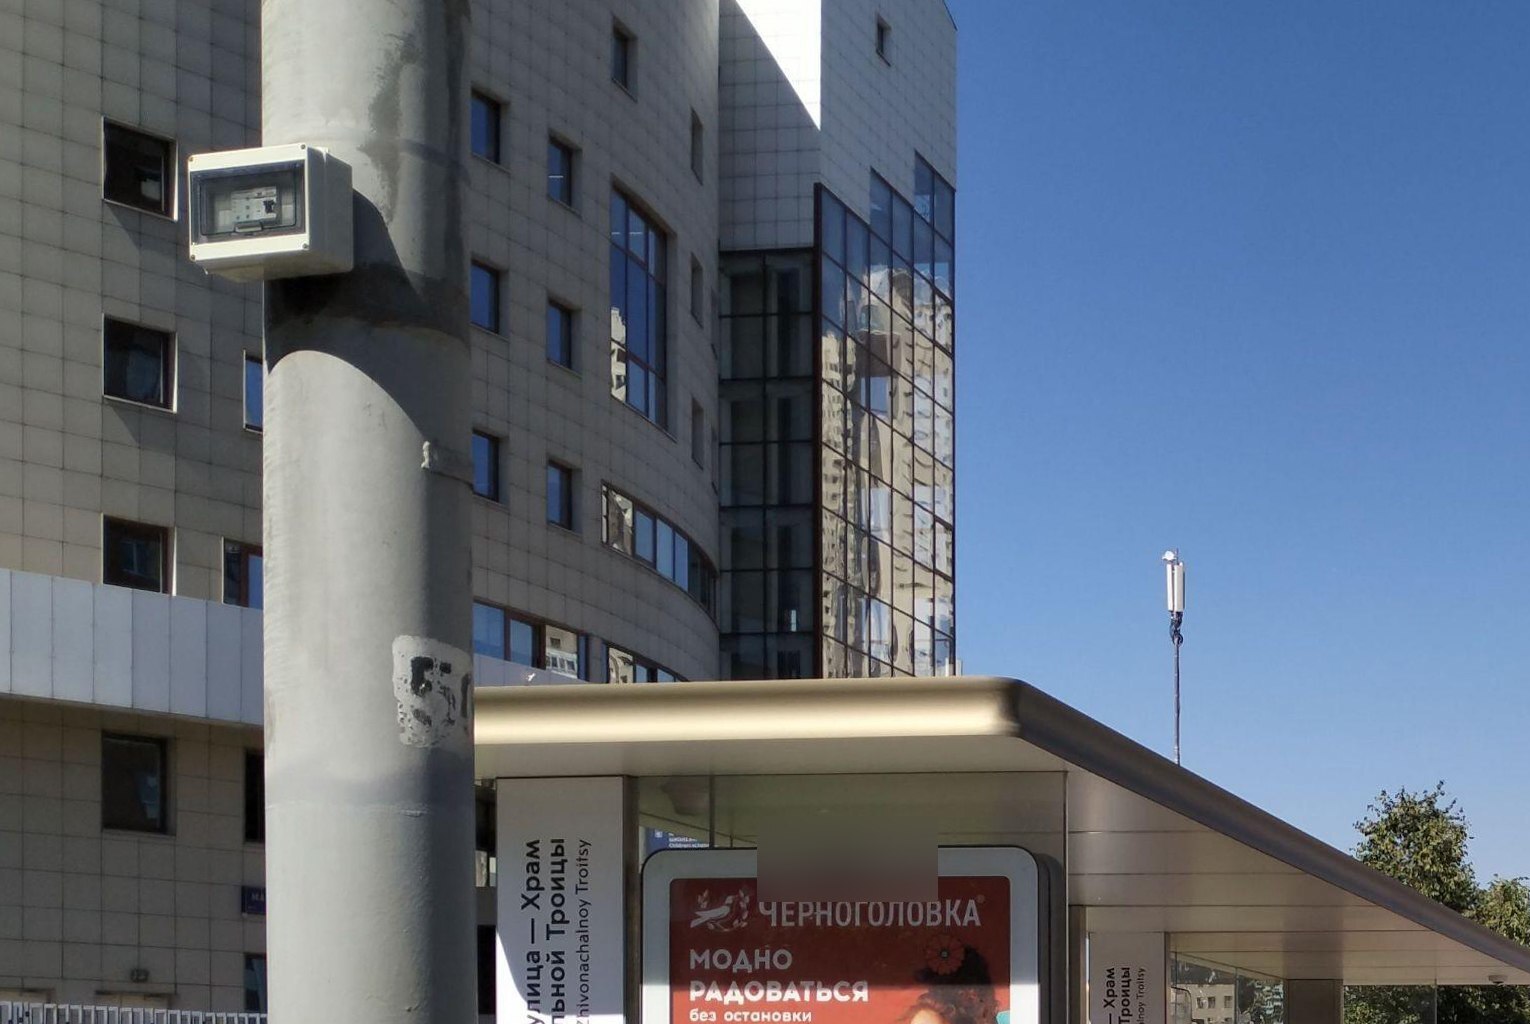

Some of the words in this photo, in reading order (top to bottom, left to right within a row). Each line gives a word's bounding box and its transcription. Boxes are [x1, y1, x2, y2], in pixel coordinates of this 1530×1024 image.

[521, 839, 545, 910] Храм
[575, 839, 592, 895] Troitsy
[546, 838, 570, 941] Троицы
[758, 899, 982, 928] ЧЕРНОГОЛОВКА
[689, 948, 793, 973] МОДНО
[689, 980, 869, 1005] РАДОВАТЬСЯ
[1103, 967, 1118, 1009] Храм
[689, 1007, 717, 1022] без
[724, 1010, 812, 1023] остановки
